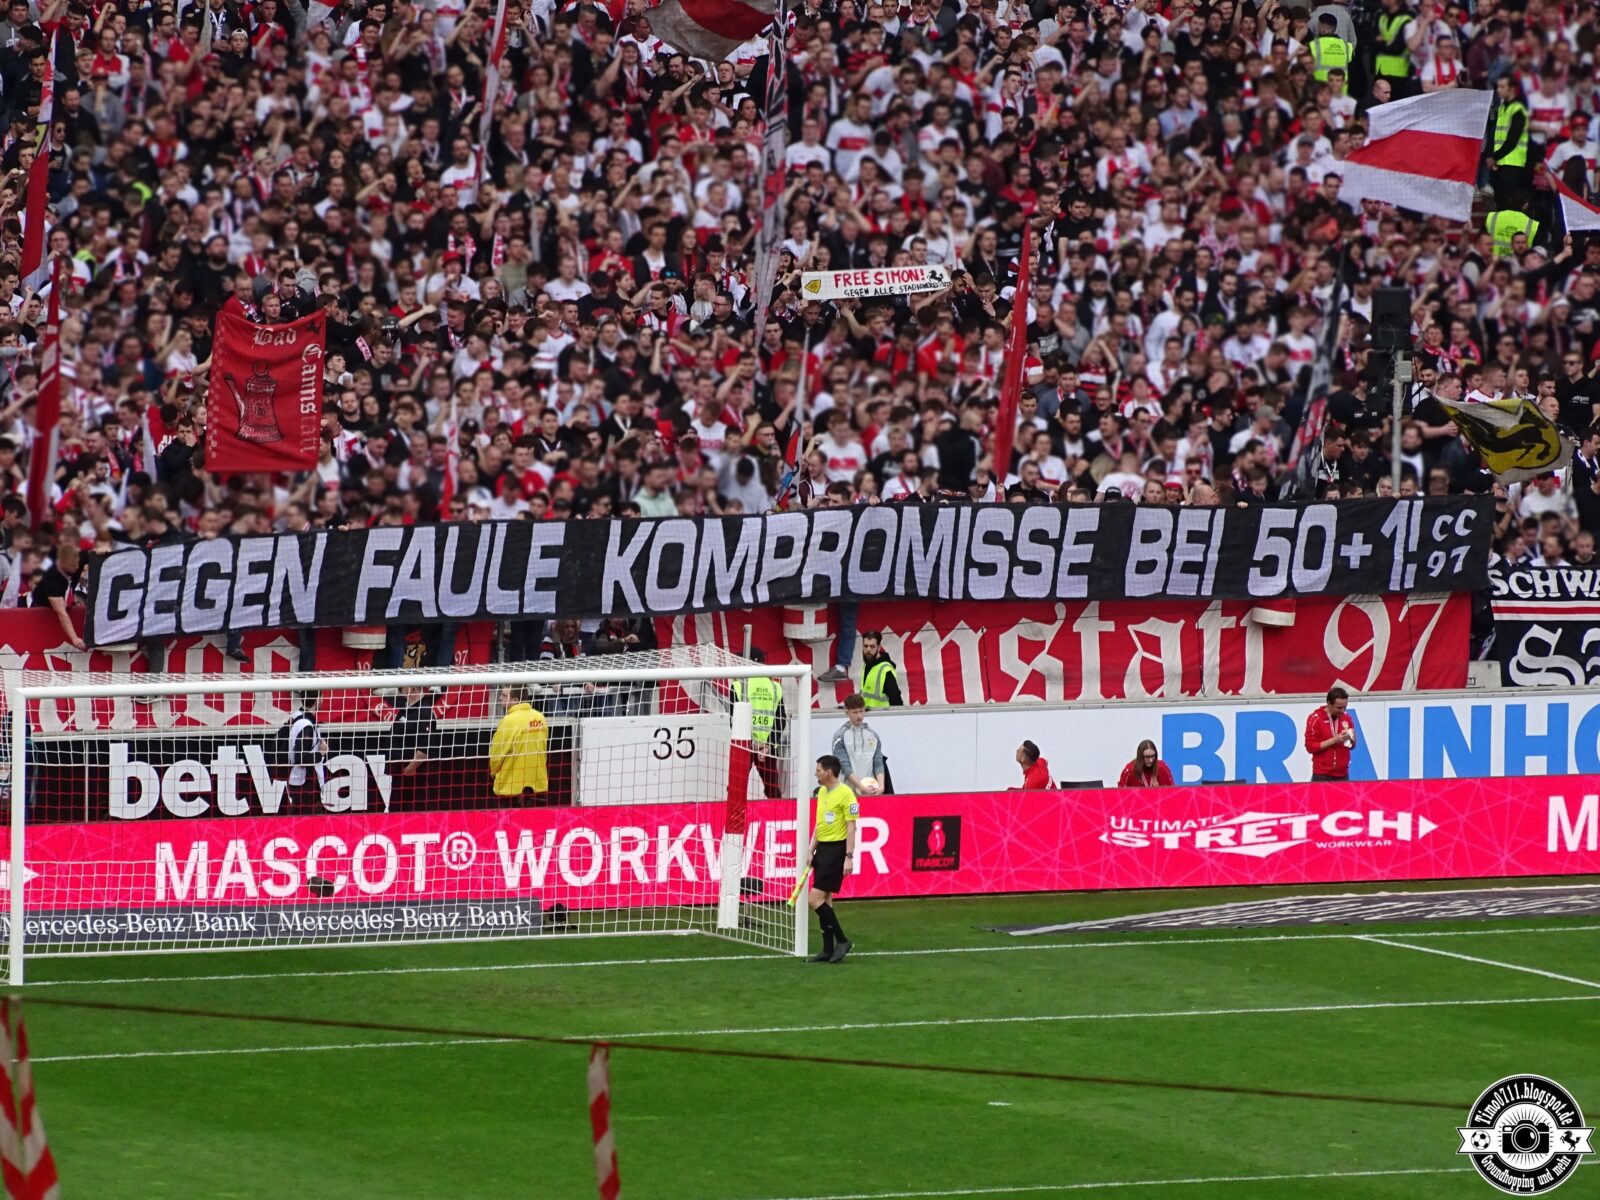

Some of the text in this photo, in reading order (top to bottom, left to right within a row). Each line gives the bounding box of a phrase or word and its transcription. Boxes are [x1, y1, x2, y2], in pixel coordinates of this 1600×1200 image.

[834, 269, 925, 288] FREE SIMON!
[844, 288, 869, 297] GEGEN
[873, 287, 894, 295] ALLE
[1432, 509, 1478, 542] CC
[94, 533, 327, 644] GEGEN
[354, 522, 565, 621] FAULE
[601, 506, 1100, 614] KOMPROMISSE
[1124, 506, 1226, 597] BEI
[1427, 545, 1471, 578] 97
[454, 650, 468, 665] 97
[1323, 594, 1450, 694] 97
[653, 727, 695, 760] 35
[1110, 815, 1225, 832] ULTIMATE
[1111, 811, 1413, 850] STRETCH
[496, 816, 890, 889] WORKWER
[1316, 839, 1392, 849] WORKWEAR
[193, 911, 257, 933] Bank
[278, 905, 532, 932] Mercedes-Benz Bank
